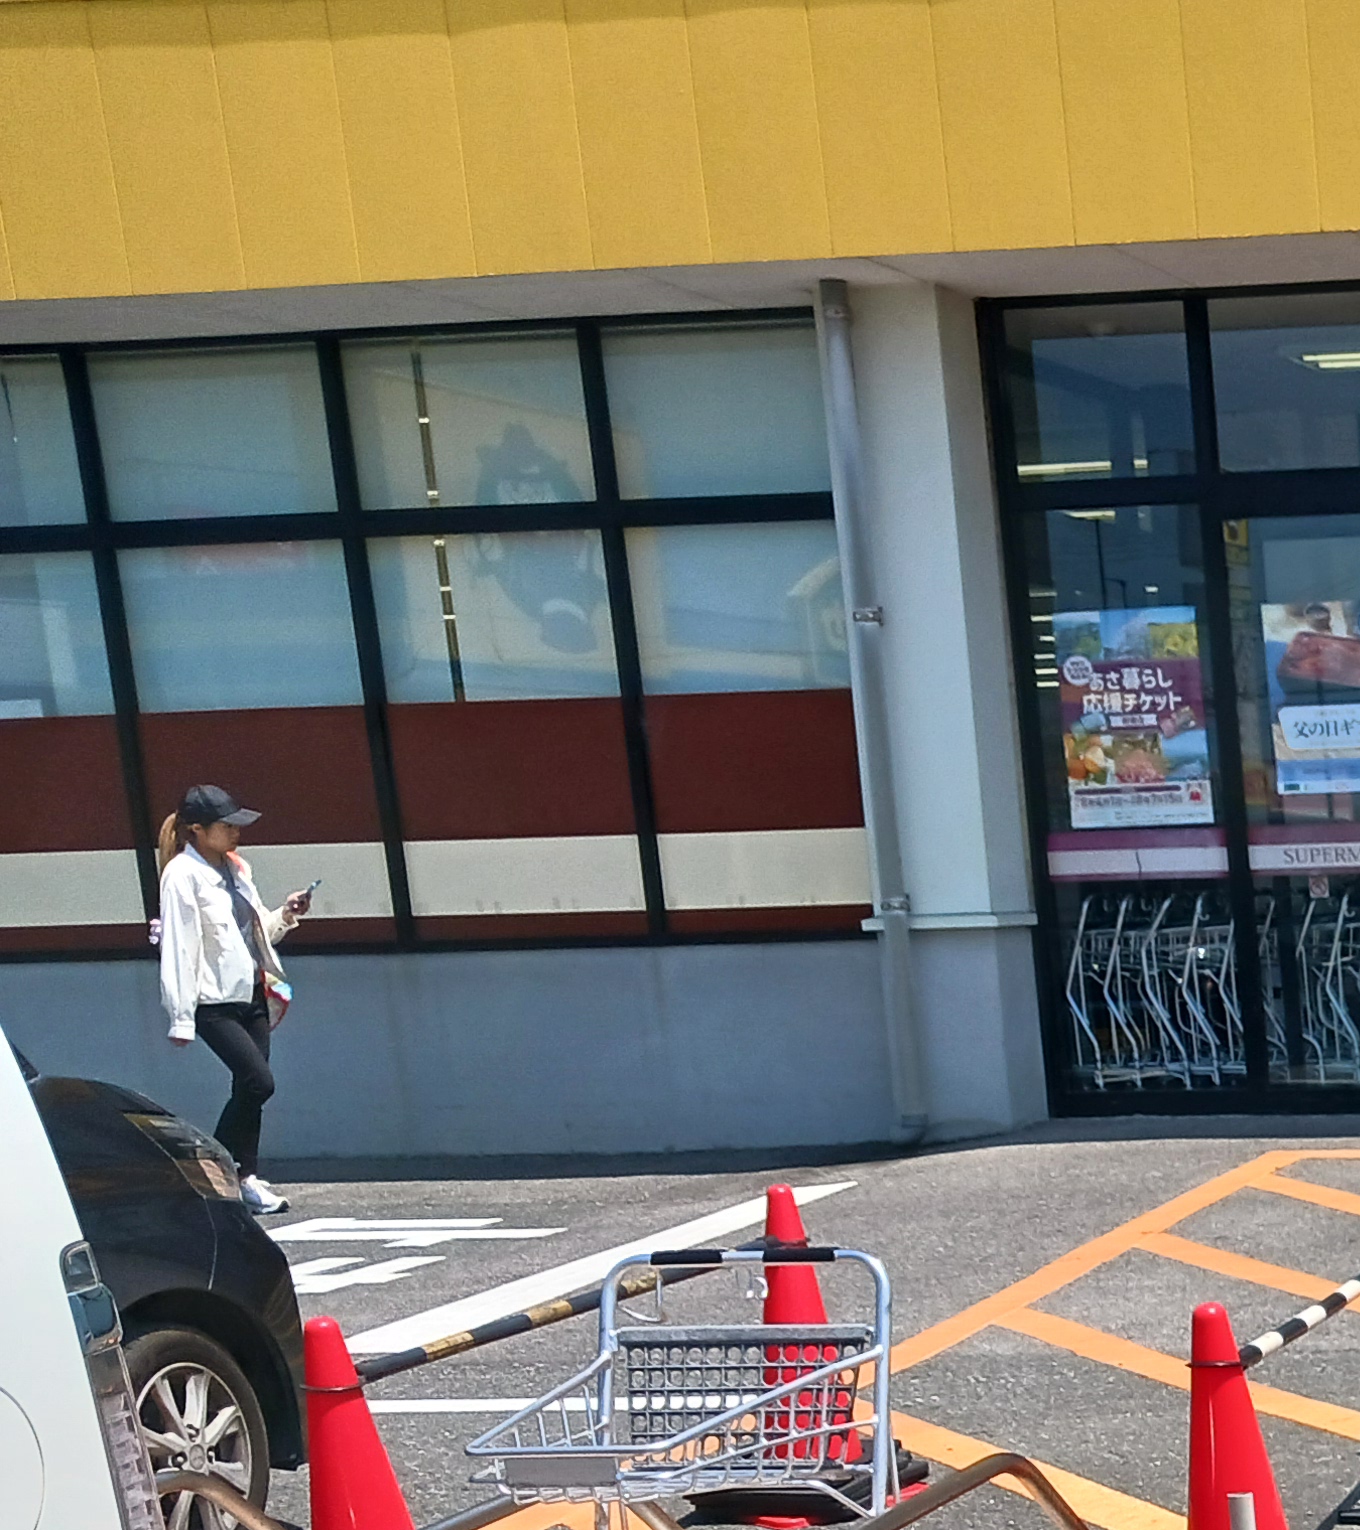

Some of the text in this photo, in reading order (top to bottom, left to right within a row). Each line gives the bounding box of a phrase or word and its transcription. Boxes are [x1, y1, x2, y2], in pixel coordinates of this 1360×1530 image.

[1089, 667, 1173, 691] あさ暮らし
[1082, 691, 1182, 714] 応援チケット
